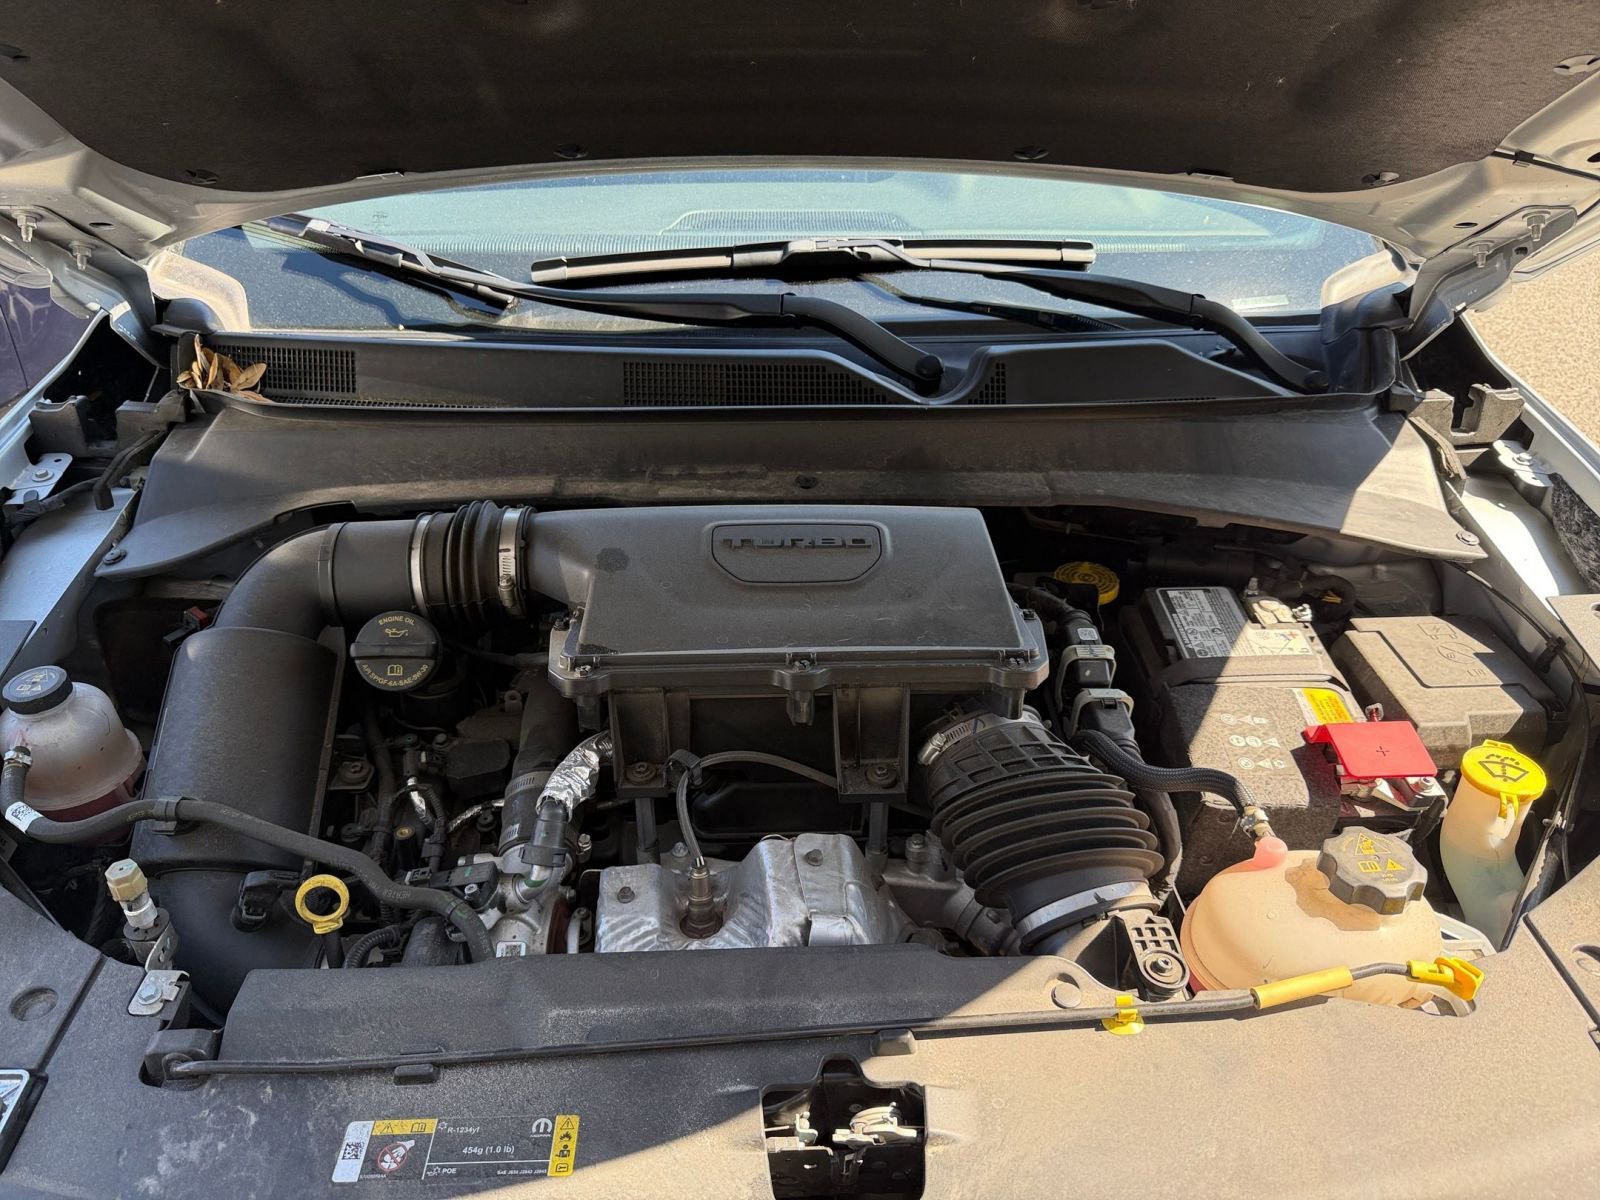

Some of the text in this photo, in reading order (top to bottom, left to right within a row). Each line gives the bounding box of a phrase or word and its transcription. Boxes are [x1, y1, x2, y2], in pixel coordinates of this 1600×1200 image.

[721, 537, 872, 549] TURBO
[378, 615, 416, 626] ENGINE OIL
[447, 1126, 480, 1135] R-1234yf
[462, 1144, 515, 1156] 454g (1.0 lb)
